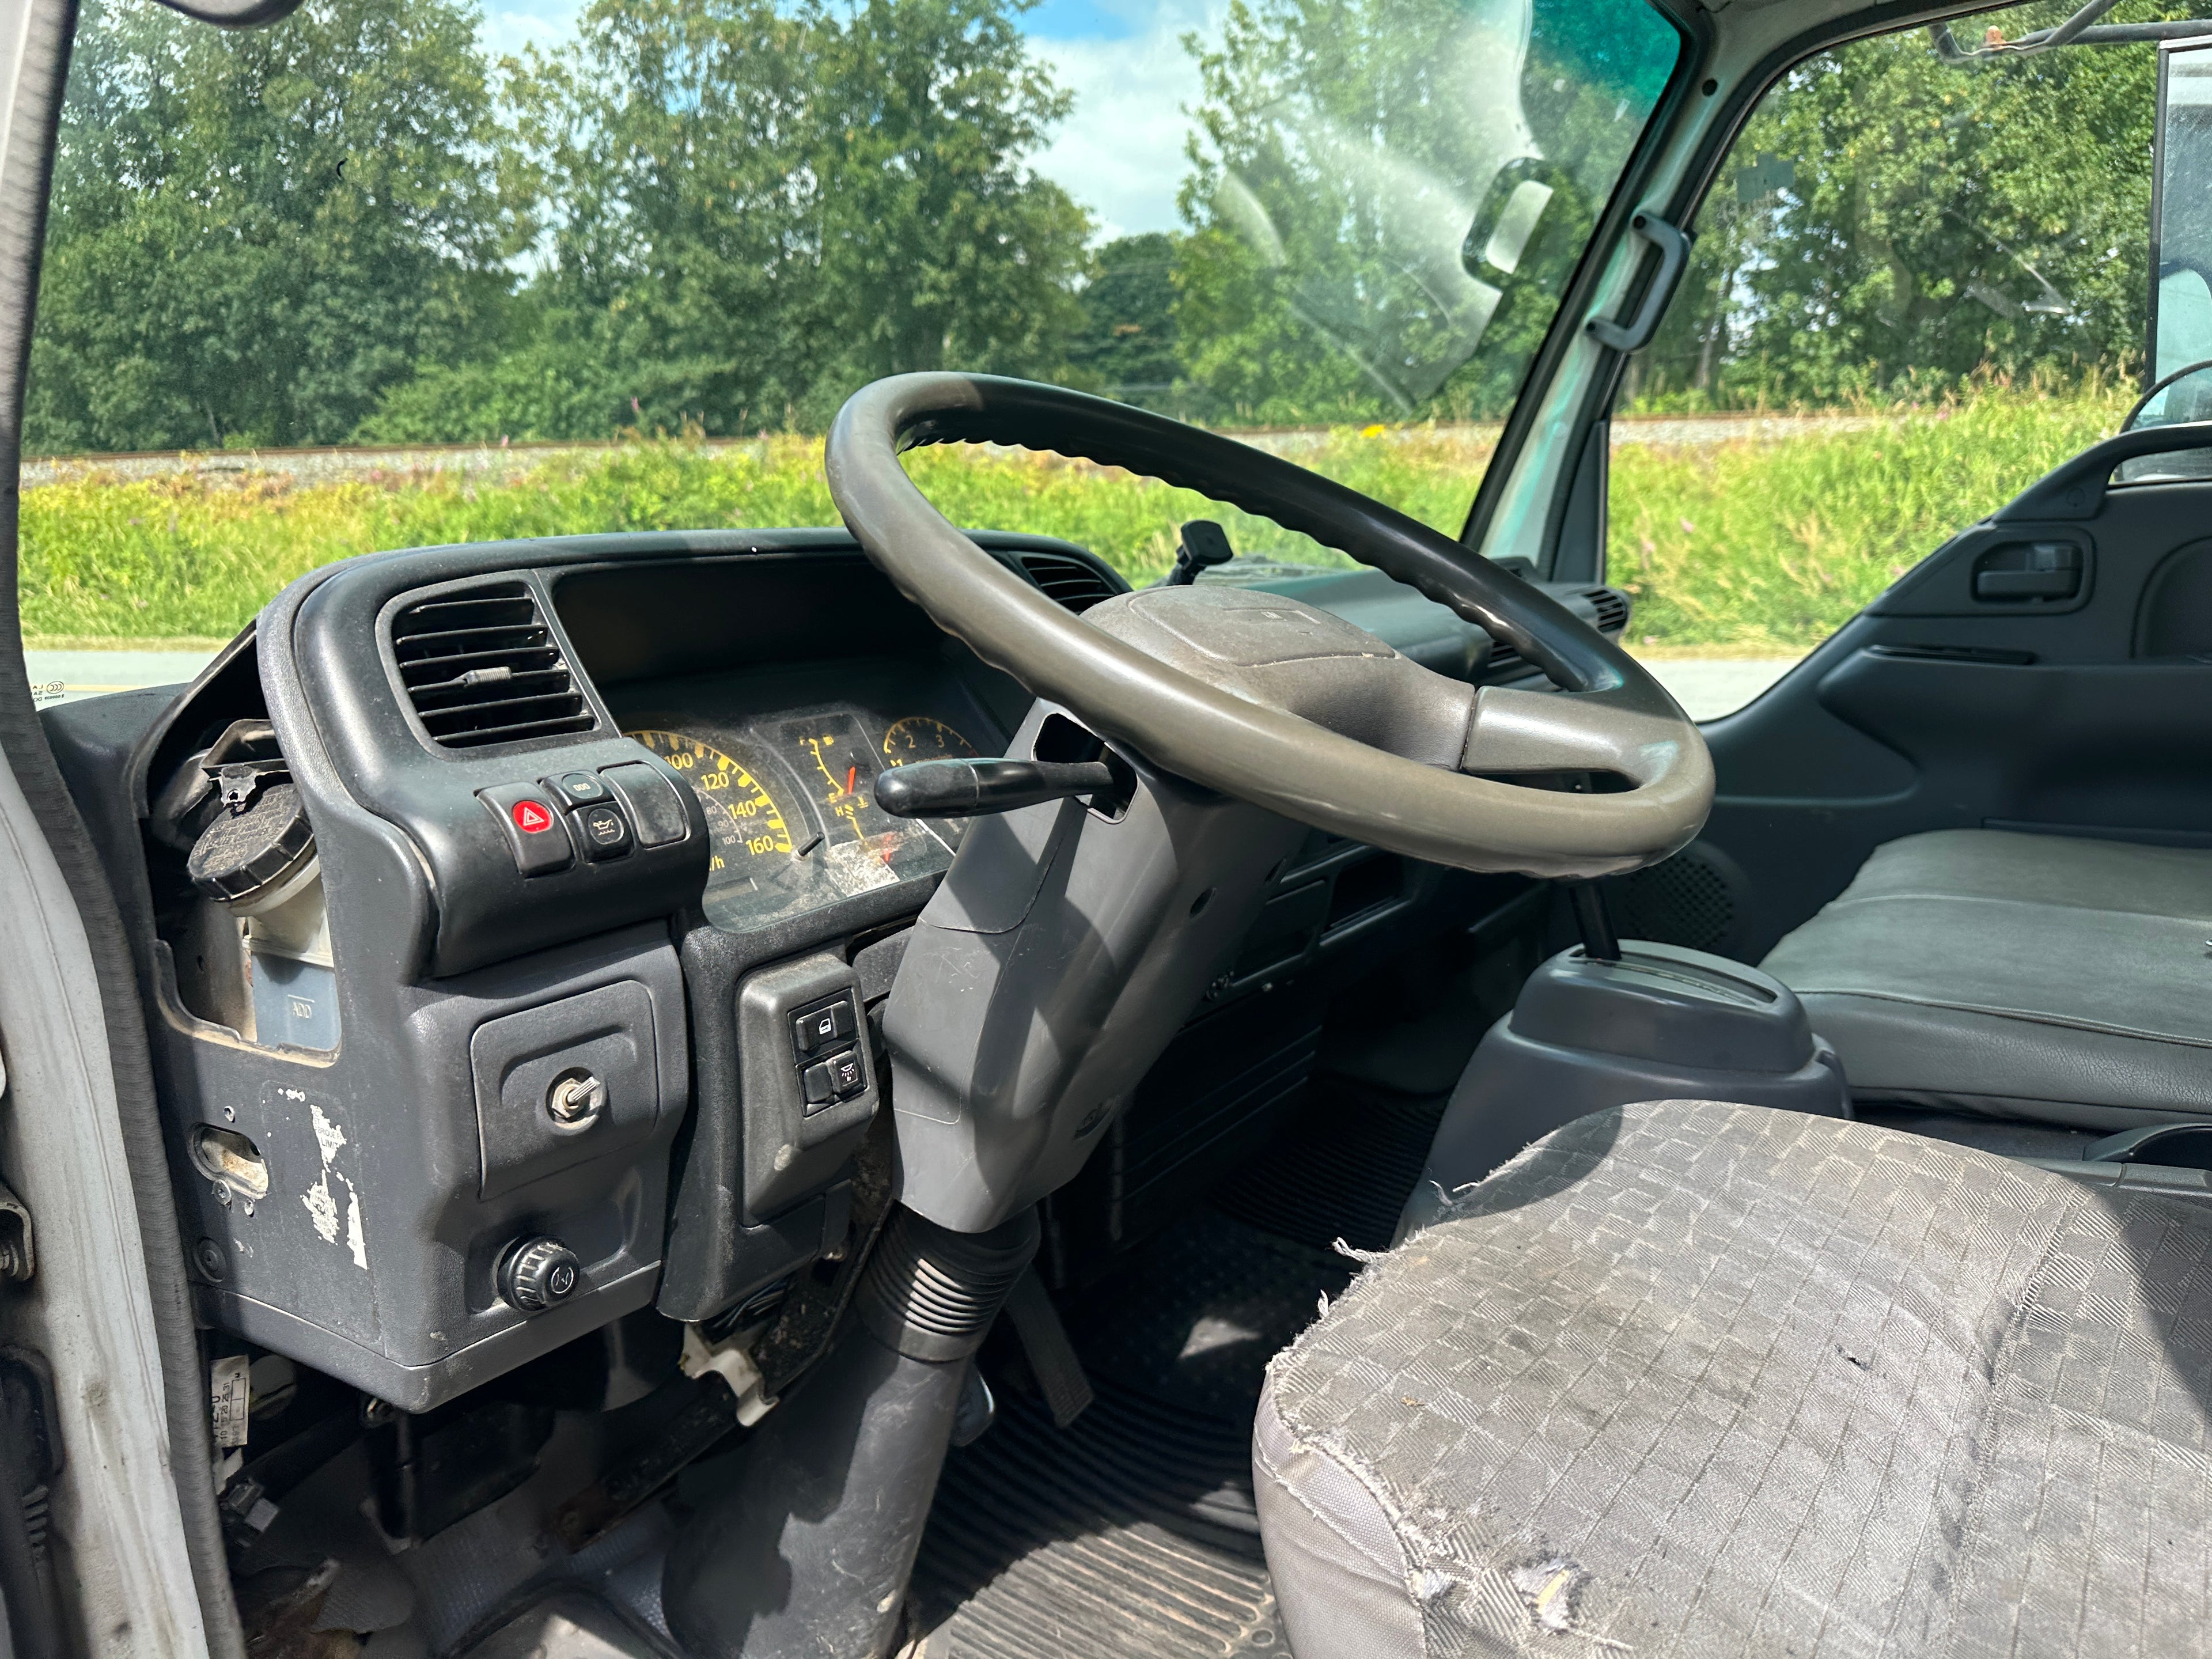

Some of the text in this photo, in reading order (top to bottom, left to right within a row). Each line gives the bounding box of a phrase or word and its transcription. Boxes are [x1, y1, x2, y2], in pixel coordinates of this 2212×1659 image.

[906, 734, 916, 748] 2
[935, 734, 945, 748] 3
[665, 752, 694, 770] 100
[701, 771, 729, 791] 120
[706, 806, 717, 815] 80
[728, 800, 756, 820] 140
[835, 806, 844, 817] H
[722, 835, 736, 844] 100
[746, 835, 774, 855] 160
